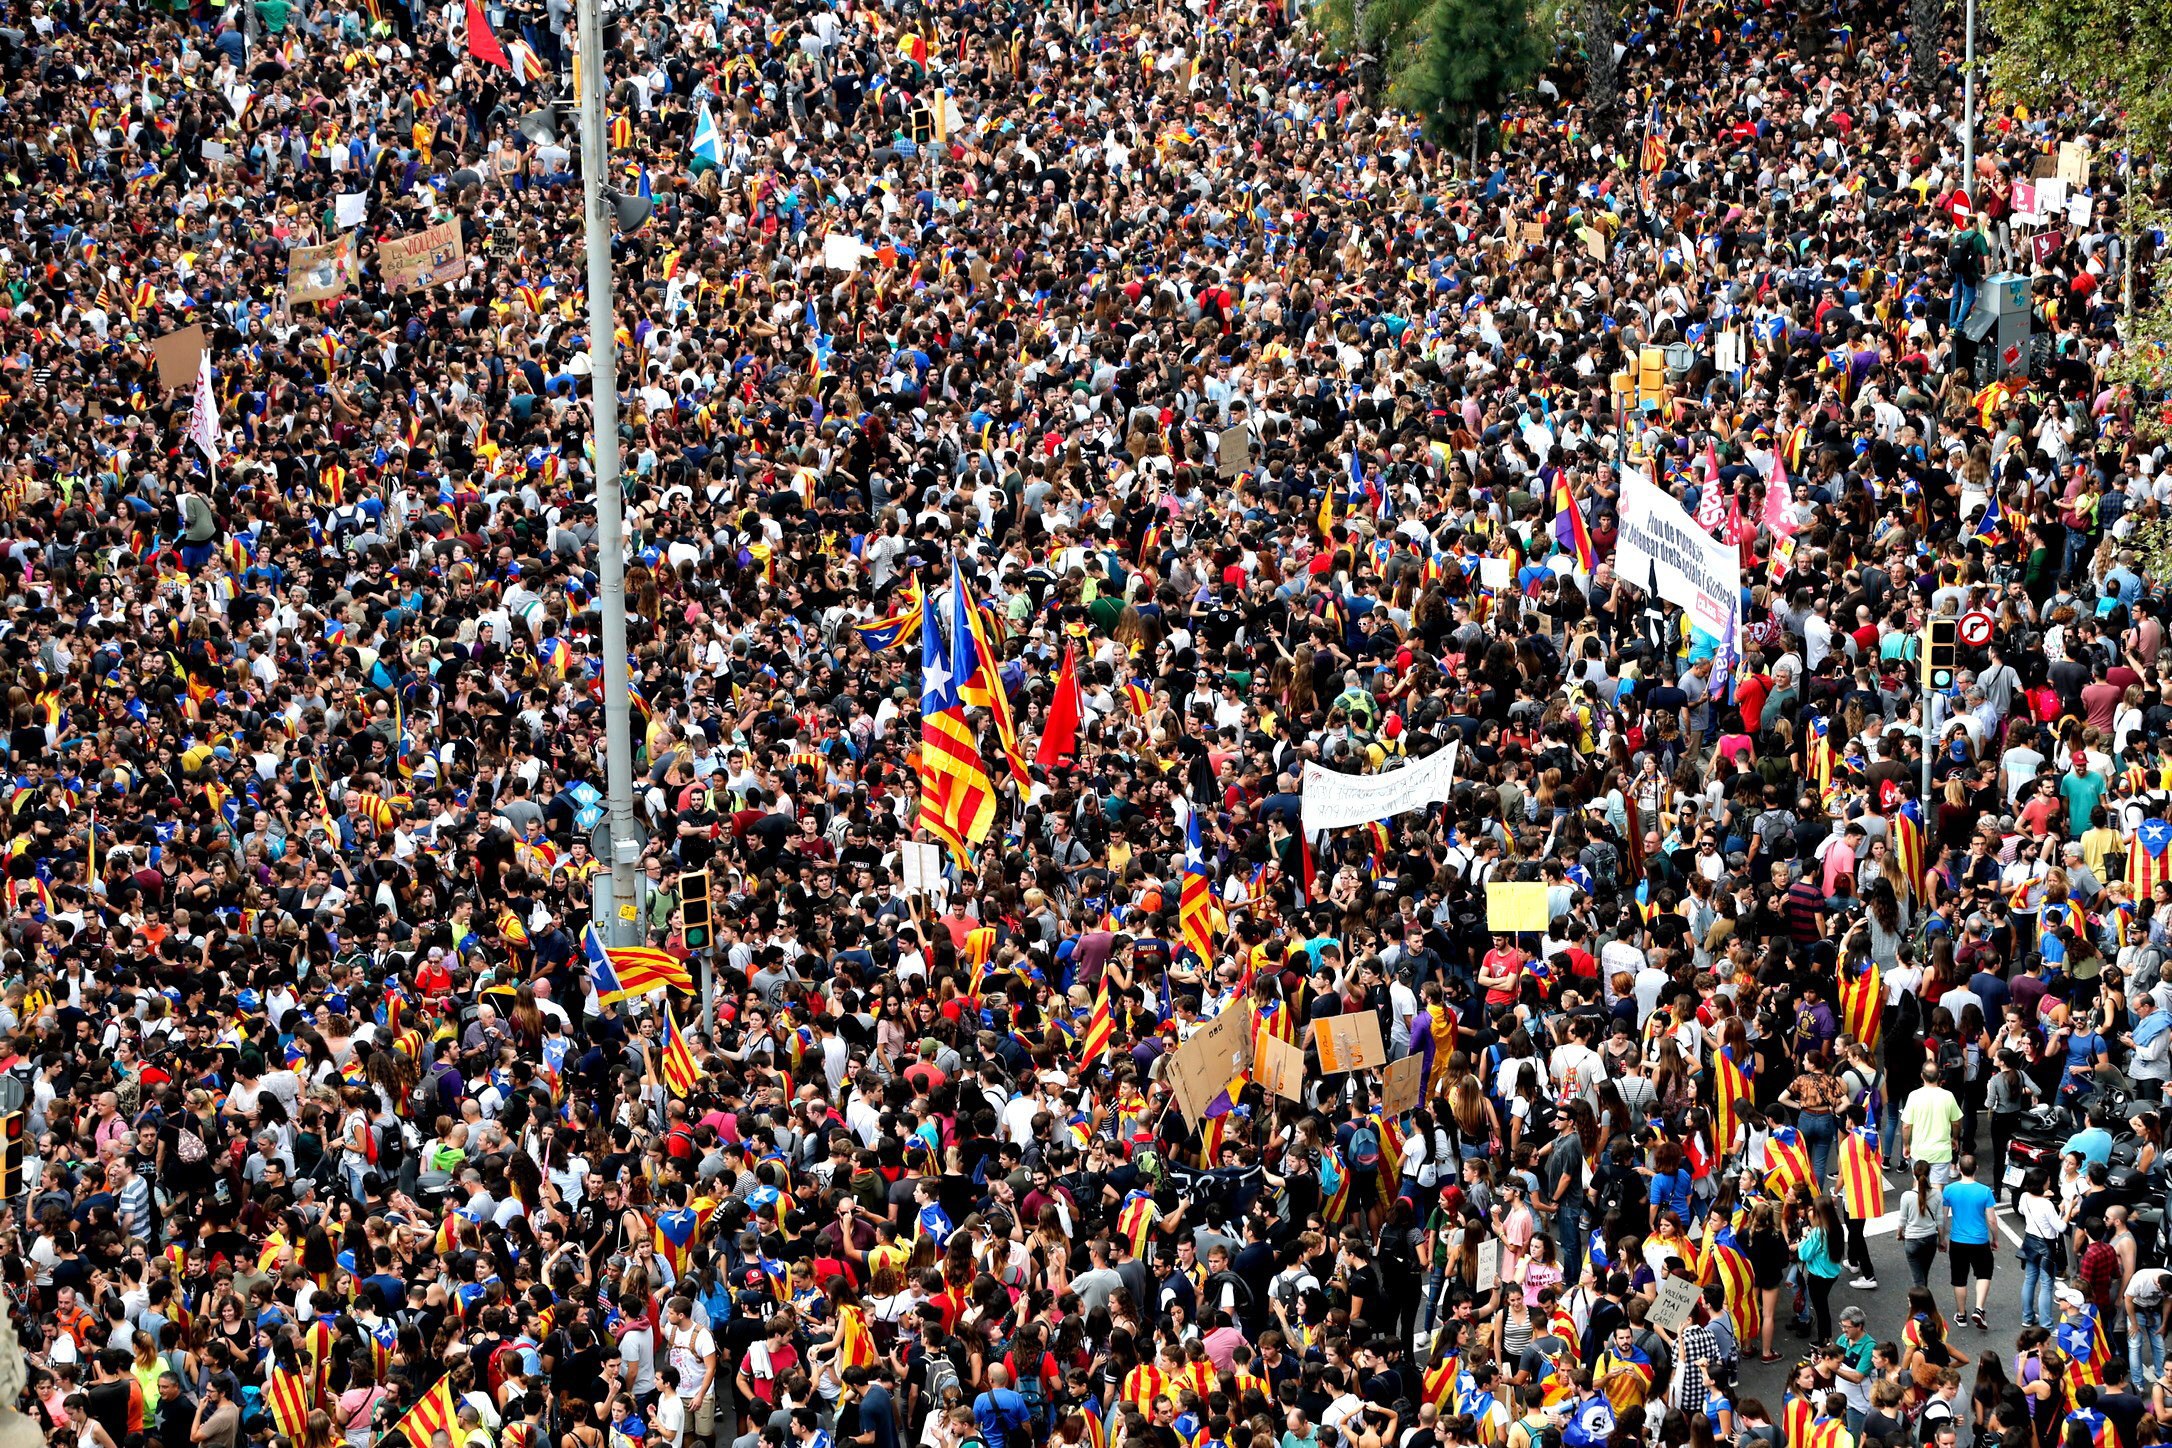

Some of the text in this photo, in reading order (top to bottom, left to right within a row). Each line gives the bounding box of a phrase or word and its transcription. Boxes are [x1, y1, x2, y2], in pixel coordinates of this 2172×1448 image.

[493, 228, 508, 237] NO
[492, 245, 515, 256] POR
[1664, 521, 1674, 544] de
[1661, 541, 1681, 570] drets
[1679, 1281, 1689, 1291] LA
[1662, 1298, 1680, 1312] MAI
